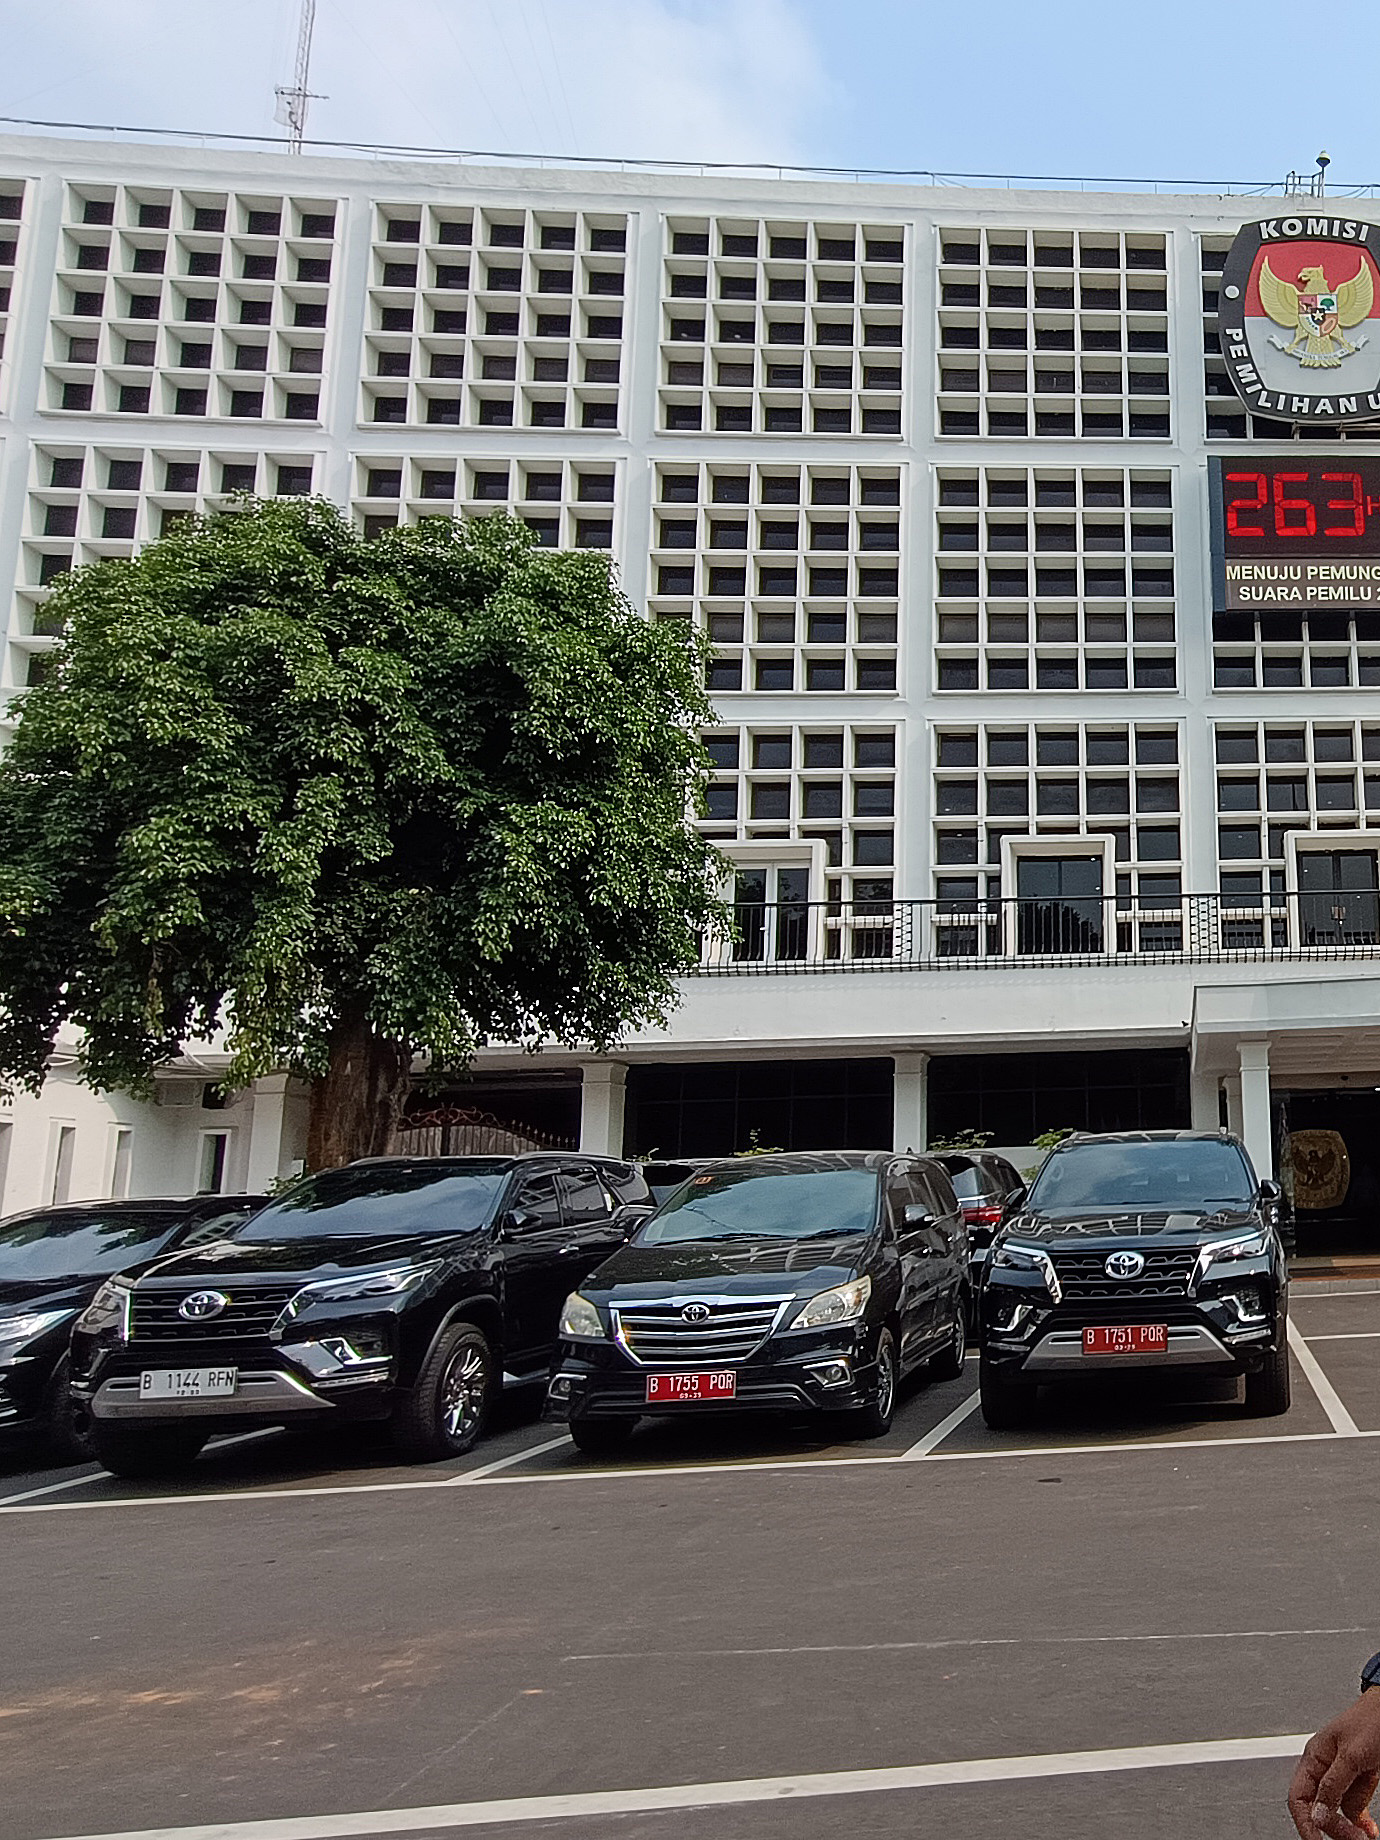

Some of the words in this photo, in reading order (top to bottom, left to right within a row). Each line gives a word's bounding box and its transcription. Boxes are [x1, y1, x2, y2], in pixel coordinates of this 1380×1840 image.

[1259, 218, 1369, 242] KOMISI
[1225, 328, 1358, 414] PEMILIHAN
[1225, 472, 1366, 537] 263
[1226, 565, 1302, 581] MENUJU
[1239, 586, 1303, 601] SUARA
[1306, 586, 1372, 601] PEMILU
[1087, 1329, 1095, 1345] B
[1104, 1327, 1132, 1344] 1751
[143, 1373, 152, 1390] B
[167, 1372, 200, 1389] 1144
[650, 1377, 659, 1393] B
[669, 1375, 699, 1392] 1755
